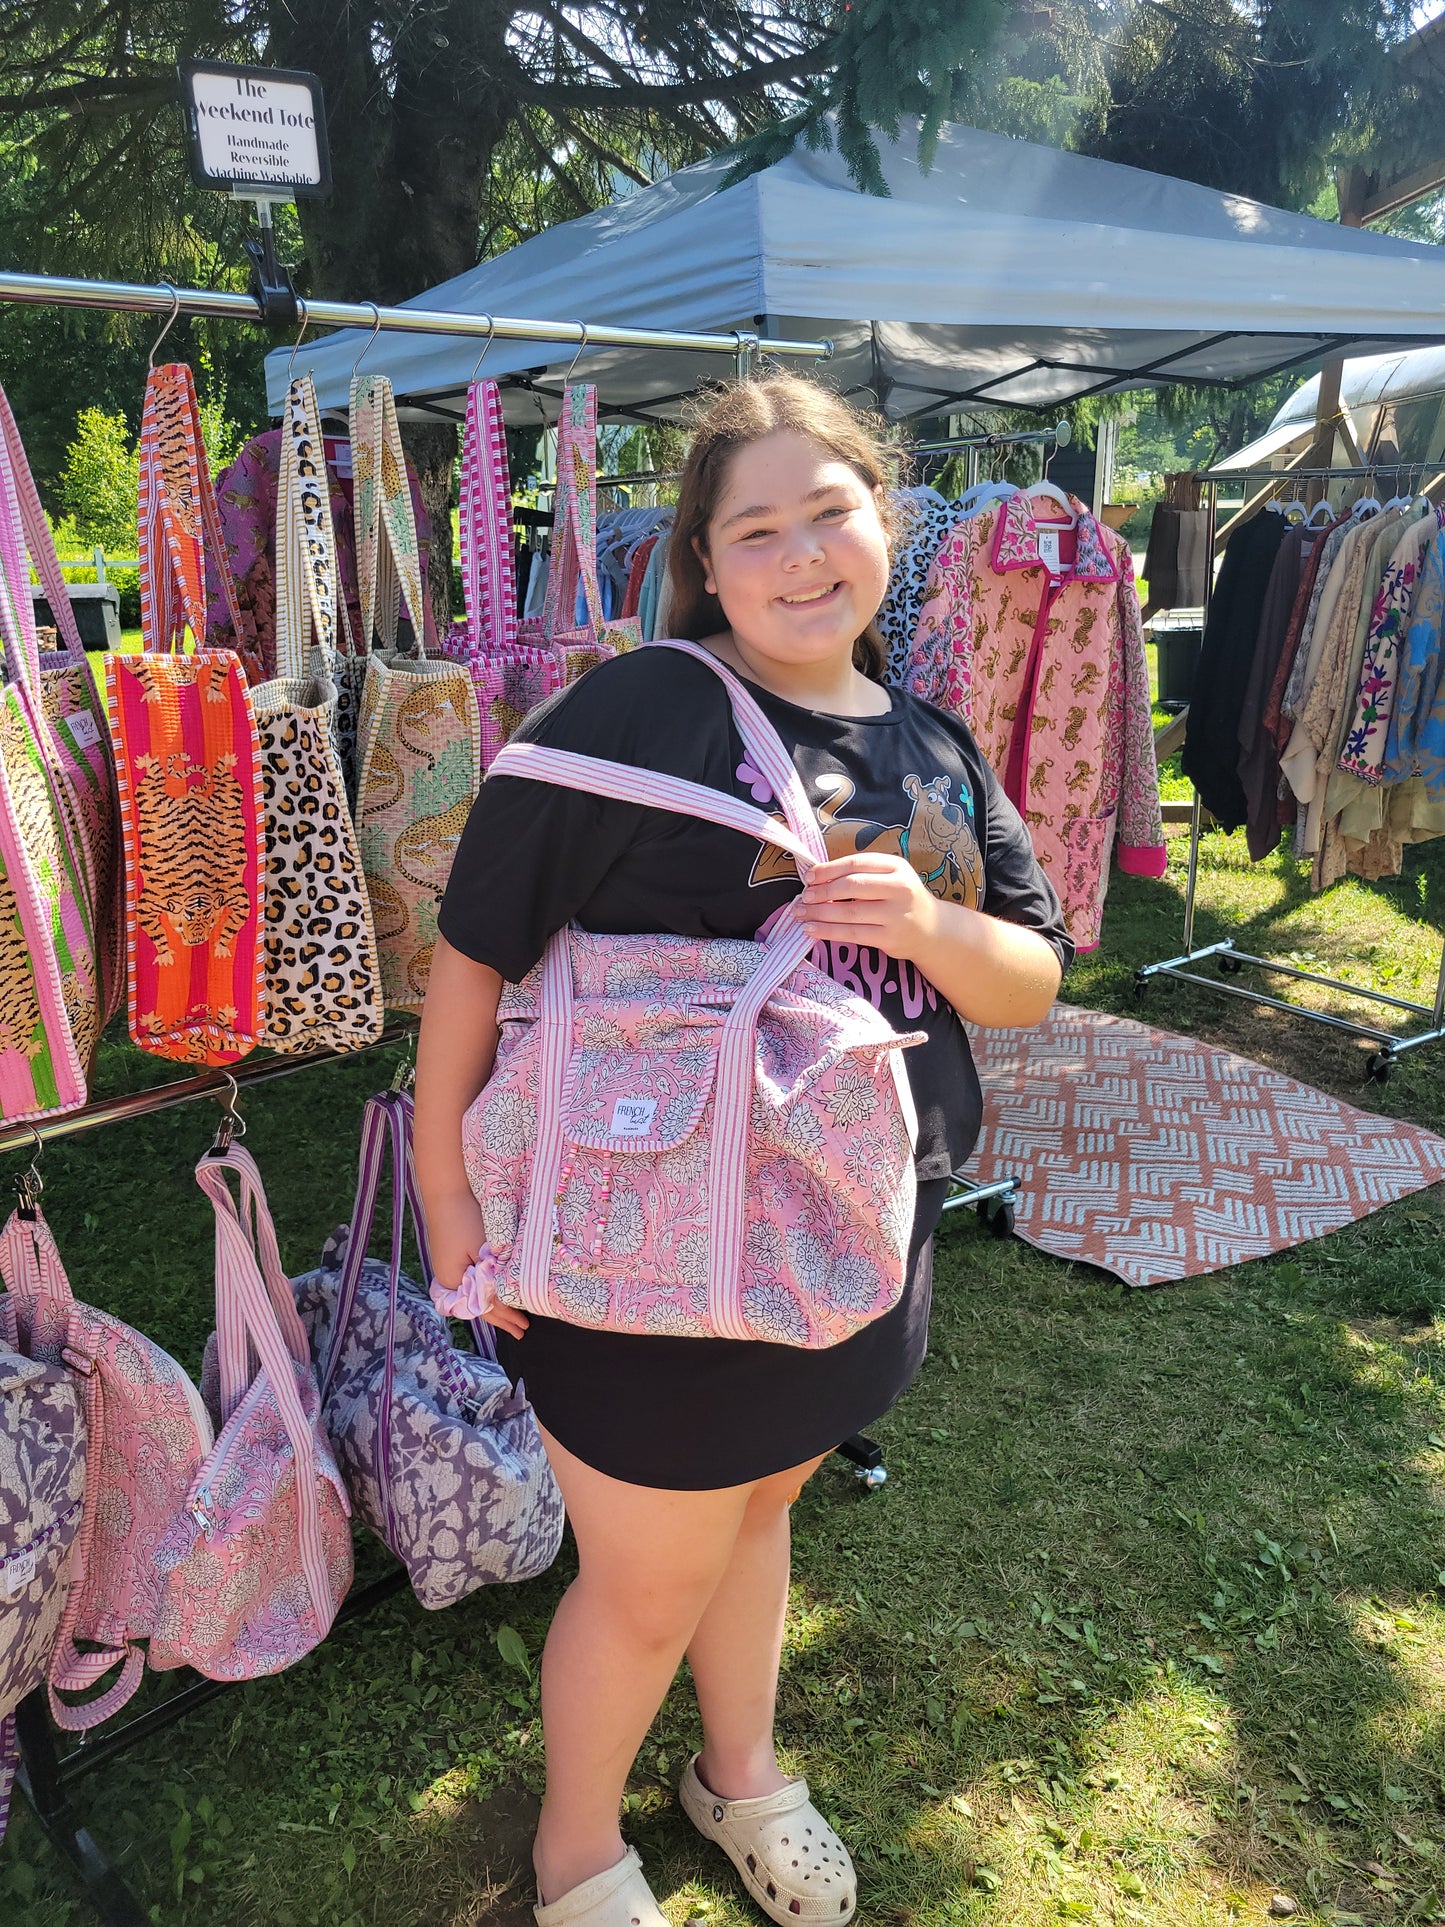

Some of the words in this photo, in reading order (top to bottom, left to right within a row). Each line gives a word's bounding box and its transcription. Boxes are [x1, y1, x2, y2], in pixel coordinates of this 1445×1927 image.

[236, 79, 267, 99] The
[276, 108, 314, 129] Tote
[227, 135, 290, 151] Handmade
[230, 152, 290, 167] Reversible
[209, 166, 258, 180] Machine
[260, 170, 312, 185] Washable
[617, 1105, 645, 1116] FRENCH
